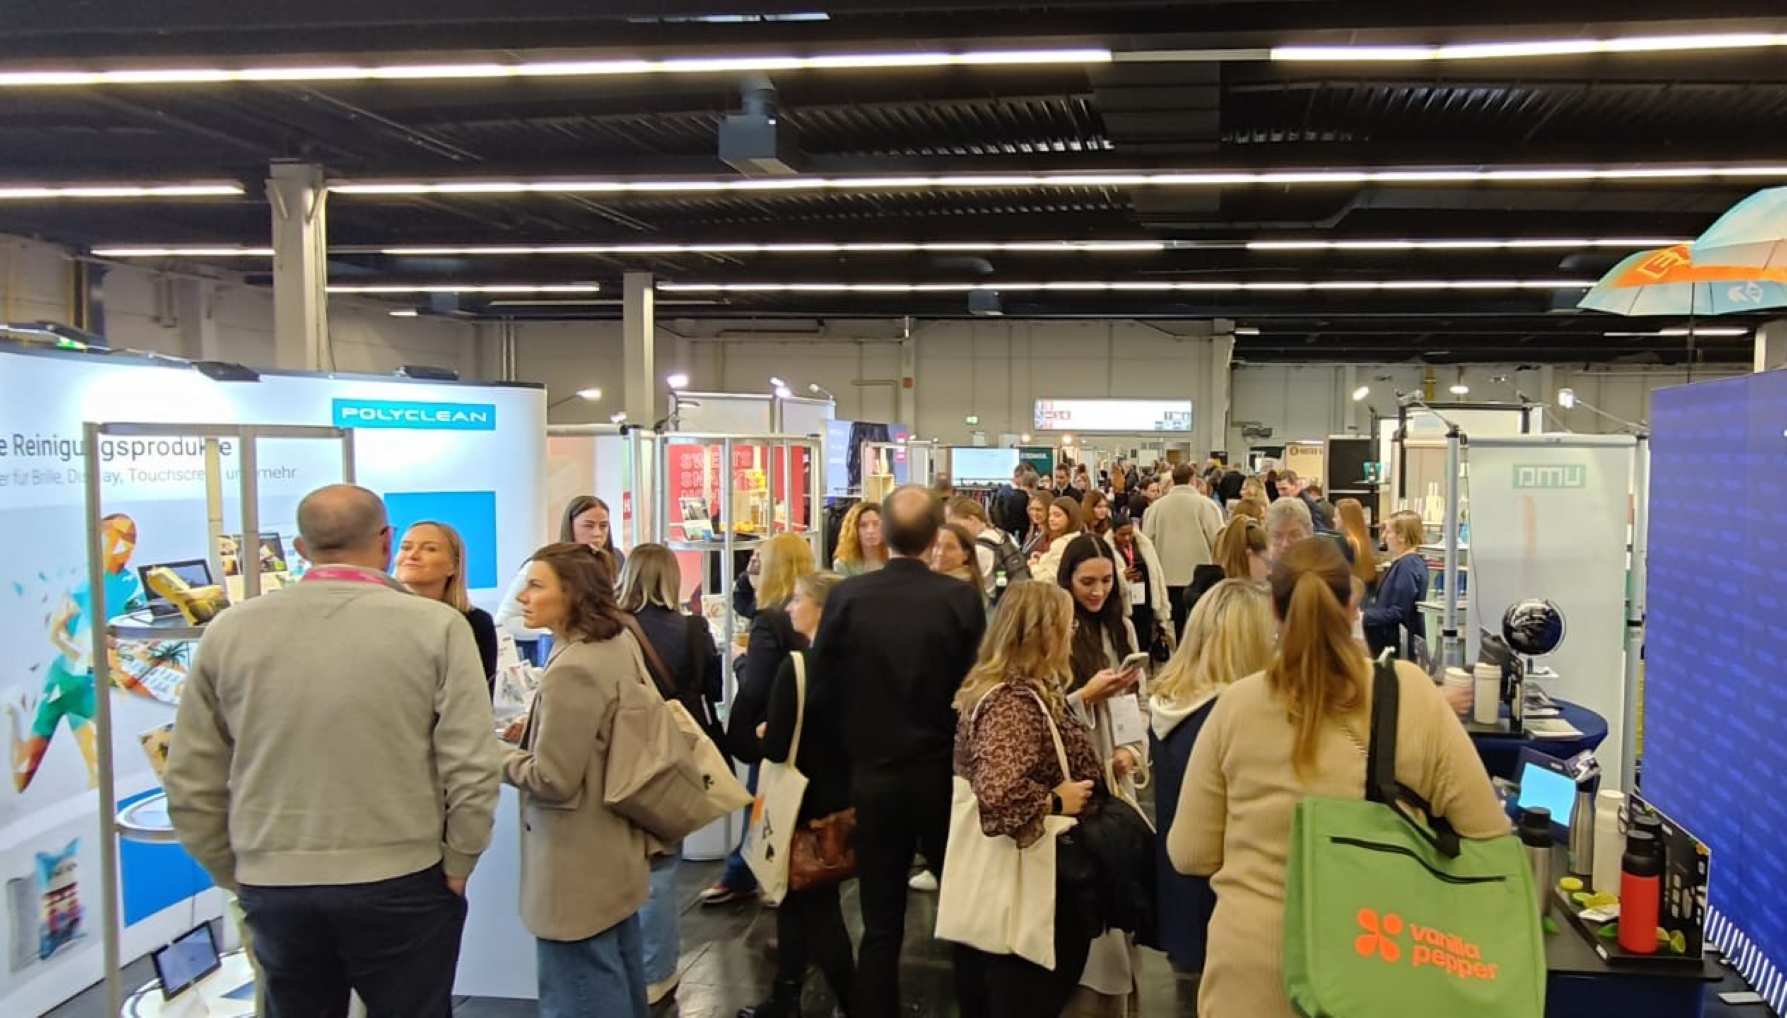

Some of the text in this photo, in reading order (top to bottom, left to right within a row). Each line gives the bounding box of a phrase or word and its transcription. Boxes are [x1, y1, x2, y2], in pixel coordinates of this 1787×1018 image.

[341, 407, 488, 422] POLYCLEAN
[12, 434, 232, 462] Reinigugsproduke
[128, 466, 210, 483] Touchscre
[1409, 923, 1481, 960] vanilla
[1412, 945, 1498, 980] pepper
